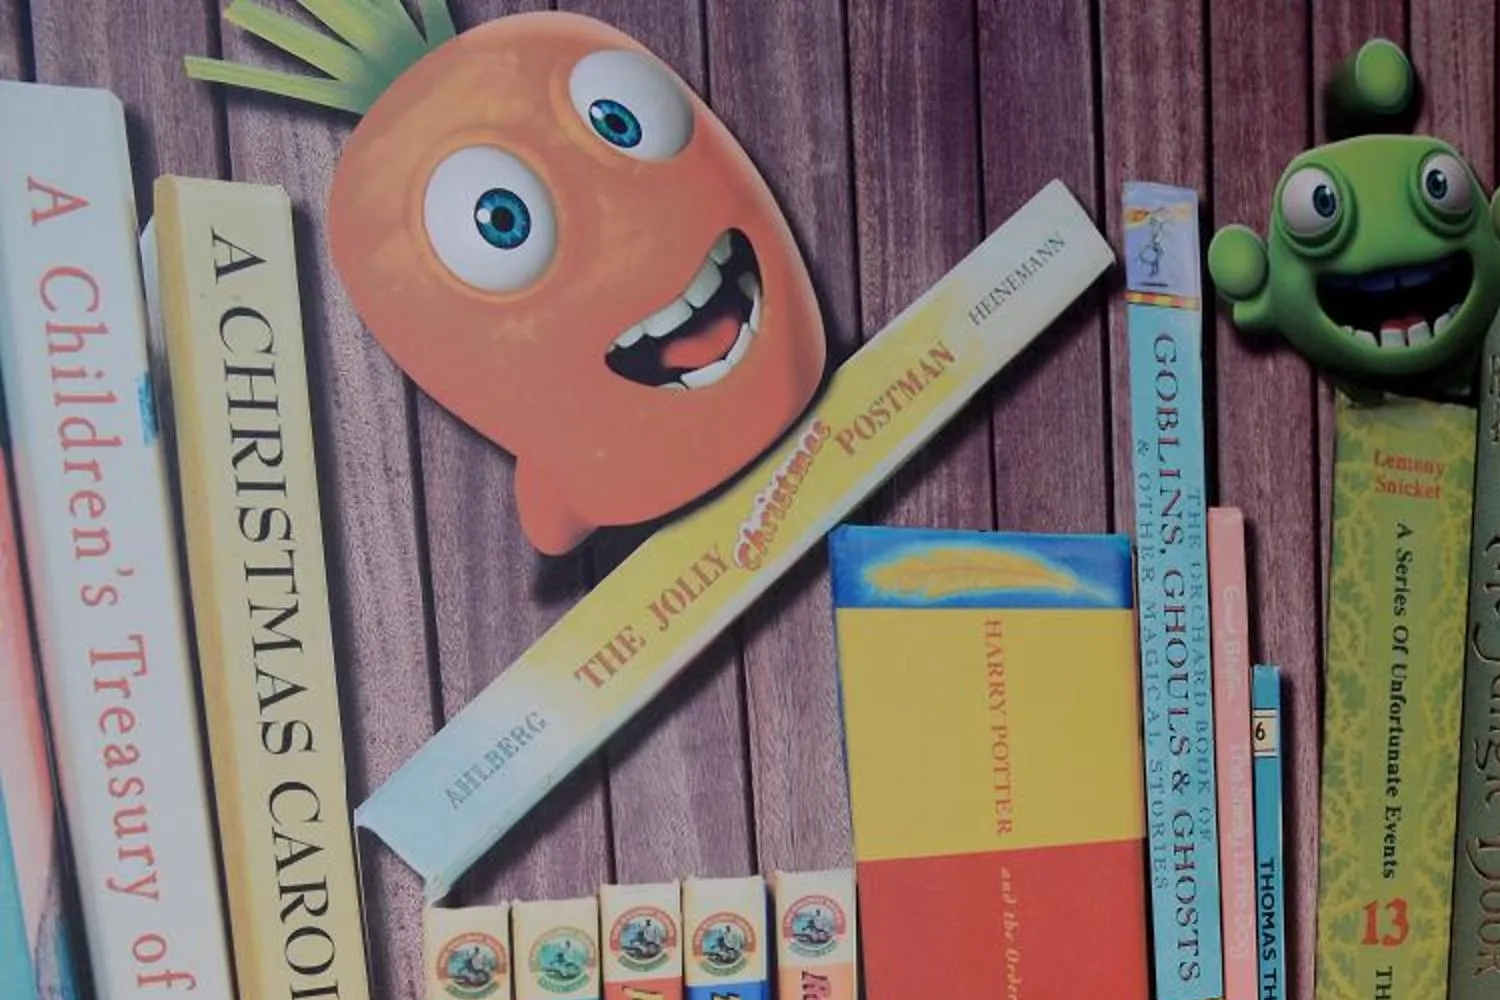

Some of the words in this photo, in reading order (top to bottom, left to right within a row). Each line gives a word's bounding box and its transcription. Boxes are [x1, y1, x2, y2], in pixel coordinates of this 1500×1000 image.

[26, 175, 91, 226] A
[211, 228, 268, 280] A
[968, 231, 1066, 327] HEINEMANN
[39, 264, 134, 606] Children's
[1373, 449, 1446, 481] Lemony
[218, 306, 316, 755] CHRISTMAS
[572, 624, 647, 690] THE
[646, 544, 731, 631] JOLLY
[733, 417, 831, 572] Christmas
[834, 342, 957, 457] POSTMAN
[1138, 472, 1155, 583] OTHER
[1375, 474, 1442, 500] Snicket
[1396, 522, 1415, 540] A
[1393, 548, 1414, 618] Series
[985, 618, 1007, 718] HARRY
[1142, 601, 1163, 748] MAGICAL
[1161, 569, 1191, 758] GHOULS
[1188, 561, 1208, 707] ORCHARD
[1391, 625, 1410, 659] Of
[89, 634, 160, 902] Treasury
[443, 711, 547, 811] AHLBERG
[1194, 718, 1211, 795] BOOK
[1254, 720, 1265, 742] 6
[1385, 664, 1410, 798] Unfortunate
[990, 724, 1014, 836] POTTER
[1149, 760, 1170, 890] STORIES
[1171, 770, 1191, 795] &
[1198, 805, 1213, 843] OF
[1000, 866, 1018, 908] and
[1383, 805, 1402, 880] Events
[1171, 809, 1201, 984] GHOSTS
[1258, 857, 1276, 961] THOMAS
[1361, 897, 1410, 948] 13
[132, 932, 196, 992] of
